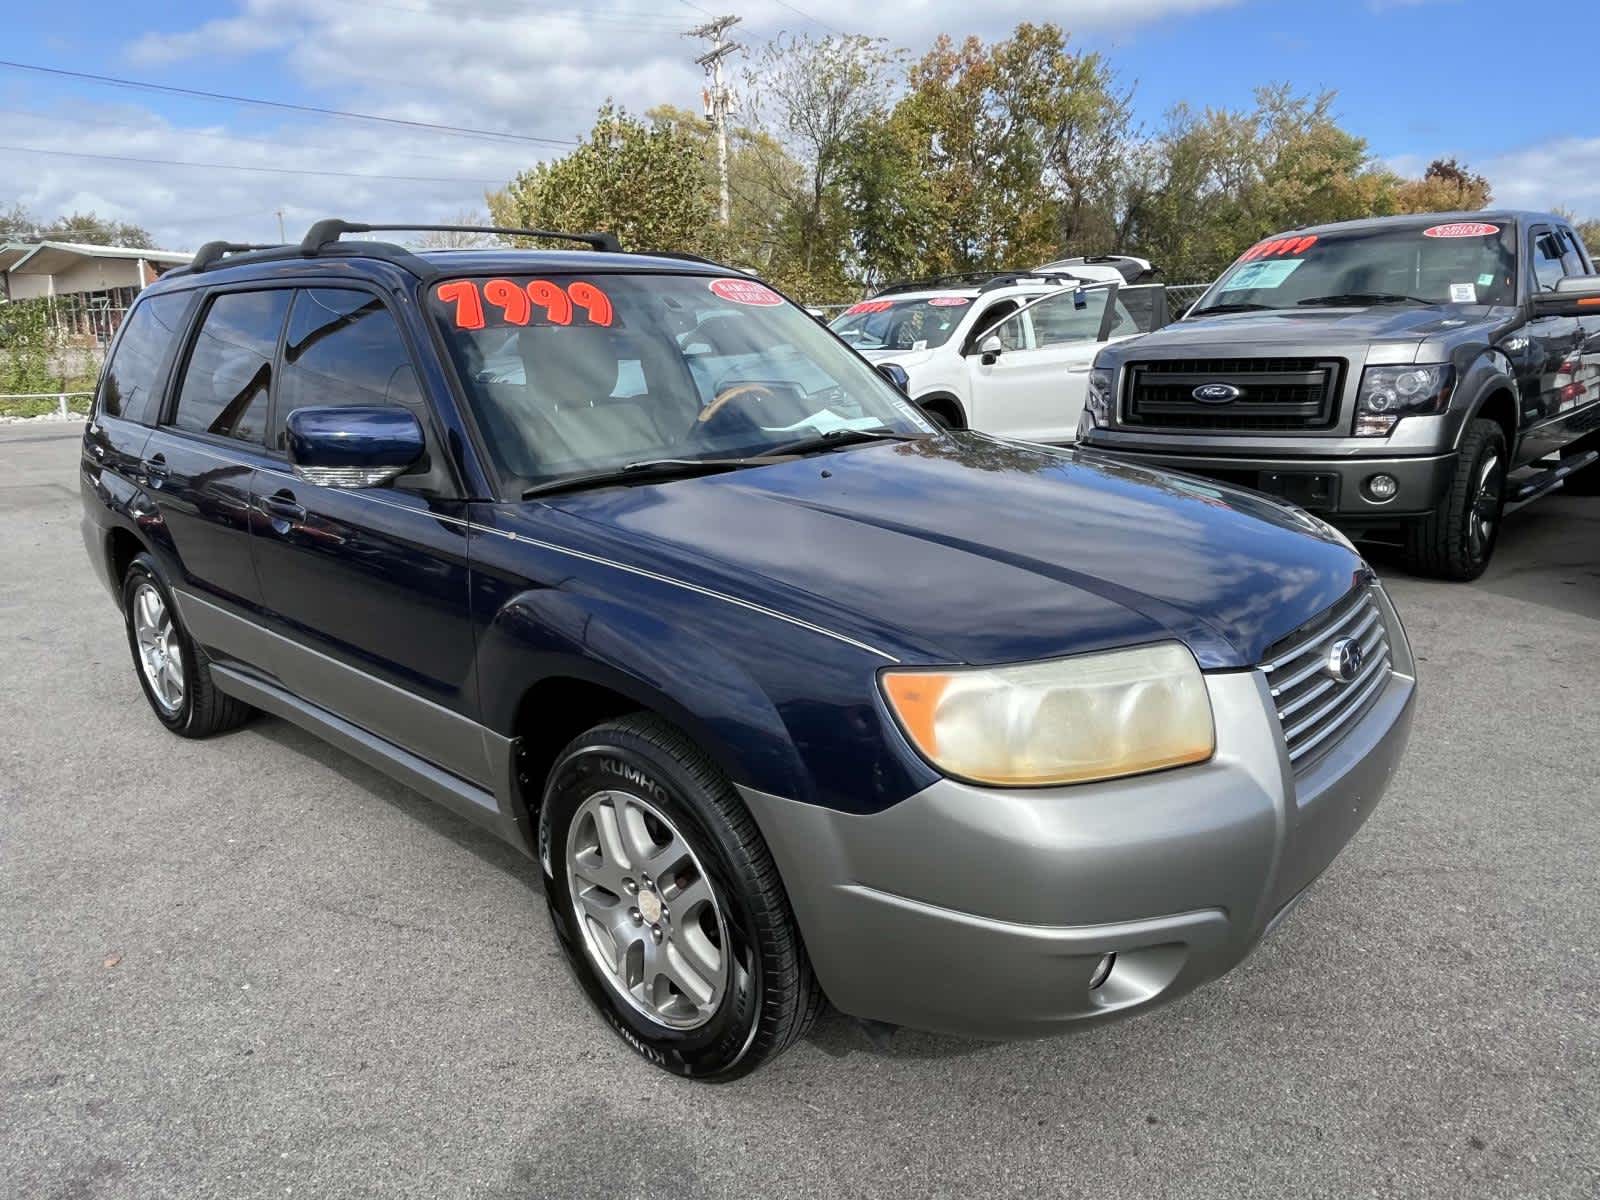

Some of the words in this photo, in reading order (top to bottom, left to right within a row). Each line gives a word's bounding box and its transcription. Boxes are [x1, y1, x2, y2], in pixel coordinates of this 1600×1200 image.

[437, 279, 612, 330] 7999
[1201, 386, 1227, 397] Ford
[600, 759, 668, 803] KUMHO
